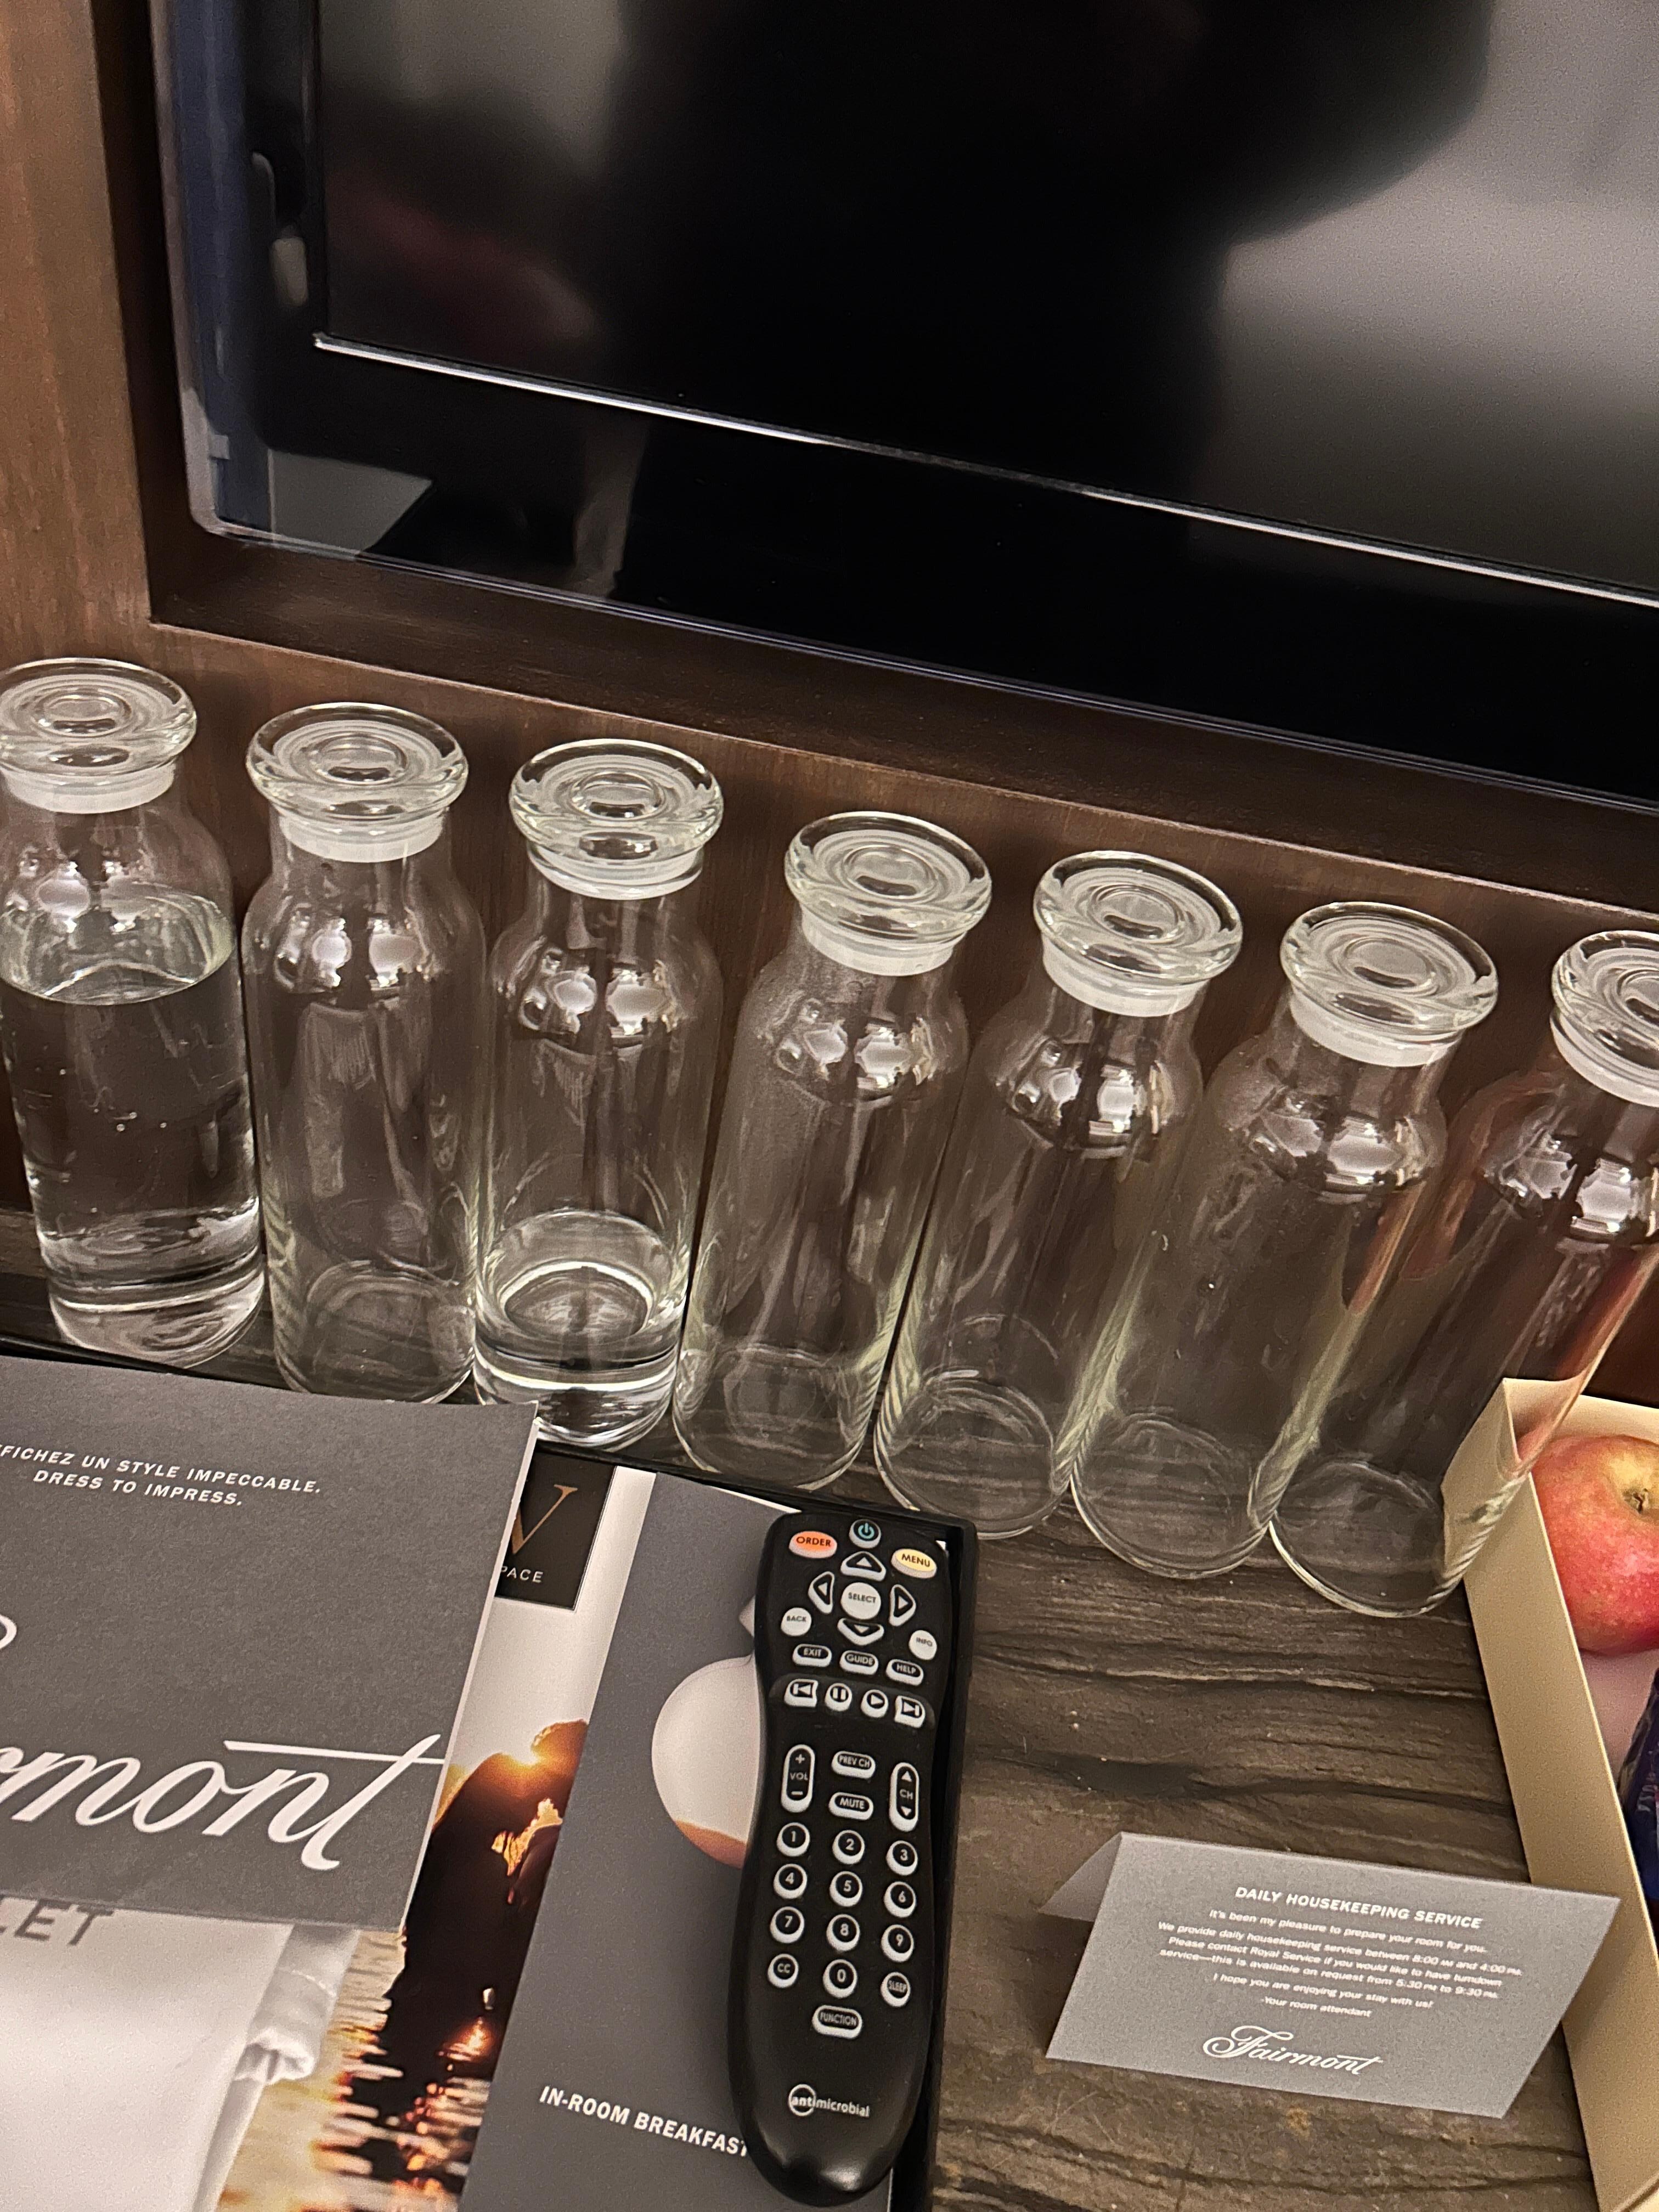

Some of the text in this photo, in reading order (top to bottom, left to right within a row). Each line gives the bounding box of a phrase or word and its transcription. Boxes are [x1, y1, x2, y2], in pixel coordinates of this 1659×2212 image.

[0, 1444, 321, 1493] FICHEZ UN STYLE IMPECCABLE.
[33, 1470, 243, 1507] DRESS TO IMPRESS.
[796, 1536, 831, 1547] ORDER
[901, 1554, 930, 1567] MENU
[848, 1592, 876, 1603] SELECT
[916, 1637, 933, 1646] INFO
[803, 1648, 822, 1657] EXIT
[847, 1654, 873, 1666] GUIDE
[896, 1664, 917, 1674] HELP
[839, 1756, 870, 1768] PREV CH
[790, 1772, 808, 1780] VOL
[900, 1789, 913, 1800] CH
[839, 1797, 865, 1809] MUTE
[791, 1831, 796, 1842] 1
[845, 1838, 855, 1850] 2
[900, 1849, 908, 1861] 3
[785, 1872, 794, 1885] 4
[843, 1880, 851, 1892] 5
[899, 1891, 906, 1903] 6
[1235, 1887, 1483, 1929] DAILY HOUSEKEEPING SERVICE
[785, 1915, 793, 1928] 7
[840, 1923, 849, 1936] 8
[1229, 1912, 1256, 1923] been
[1260, 1916, 1277, 1927] my
[1278, 1920, 1327, 1933] pleasure
[1329, 1926, 1341, 1934] to
[1344, 1928, 1386, 1940] prepare
[1389, 1934, 1413, 1944] your
[1414, 1937, 1444, 1948] room
[1447, 1941, 1463, 1950] for
[896, 1934, 903, 1946] 9
[1159, 1921, 1175, 1931] We
[1177, 1925, 1217, 1937] provide
[1219, 1929, 1245, 1941] daily
[1246, 1932, 1322, 1952] housekeeping
[1324, 1944, 1363, 1956] service
[1365, 1948, 1410, 1961] between
[1456, 1961, 1478, 1971] and
[777, 1963, 791, 1973] CC
[1169, 1936, 1206, 1948] Please
[1207, 1942, 1249, 1954] contact
[1250, 1946, 1280, 1959] Royal
[1282, 1951, 1322, 1964] Service
[1324, 1956, 1334, 1965] if
[1356, 1961, 1388, 1972] would
[1389, 1965, 1408, 1975] like
[1411, 1968, 1423, 1976] to
[1425, 1970, 1451, 1980] have
[1454, 1973, 1503, 1987] turndown
[837, 1969, 847, 1983] 0
[1236, 1957, 1247, 1967] is
[1250, 1959, 1300, 1974] available
[1303, 1967, 1318, 1976] on
[1321, 1970, 1364, 1982] request
[1367, 1975, 1393, 1985] from
[1440, 1985, 1452, 1993] to
[888, 1980, 907, 1993] SLEEP
[1213, 1973, 1217, 1982] I
[1220, 1974, 1248, 1984] hope
[1249, 1978, 1269, 1988] you
[1272, 1980, 1290, 1989] are
[1293, 1984, 1338, 1998] enjoying
[1339, 1990, 1363, 2000] your
[1365, 1994, 1389, 2004] stay
[1390, 1997, 1413, 2006] with
[1289, 2001, 1317, 2011] room
[1320, 2005, 1372, 2018] attendant
[820, 2012, 857, 2026] FUNCTION
[1203, 2025, 1383, 2074] Fairmont
[539, 2086, 630, 2125] IN-ROOM
[791, 2096, 870, 2118] antimicrobial
